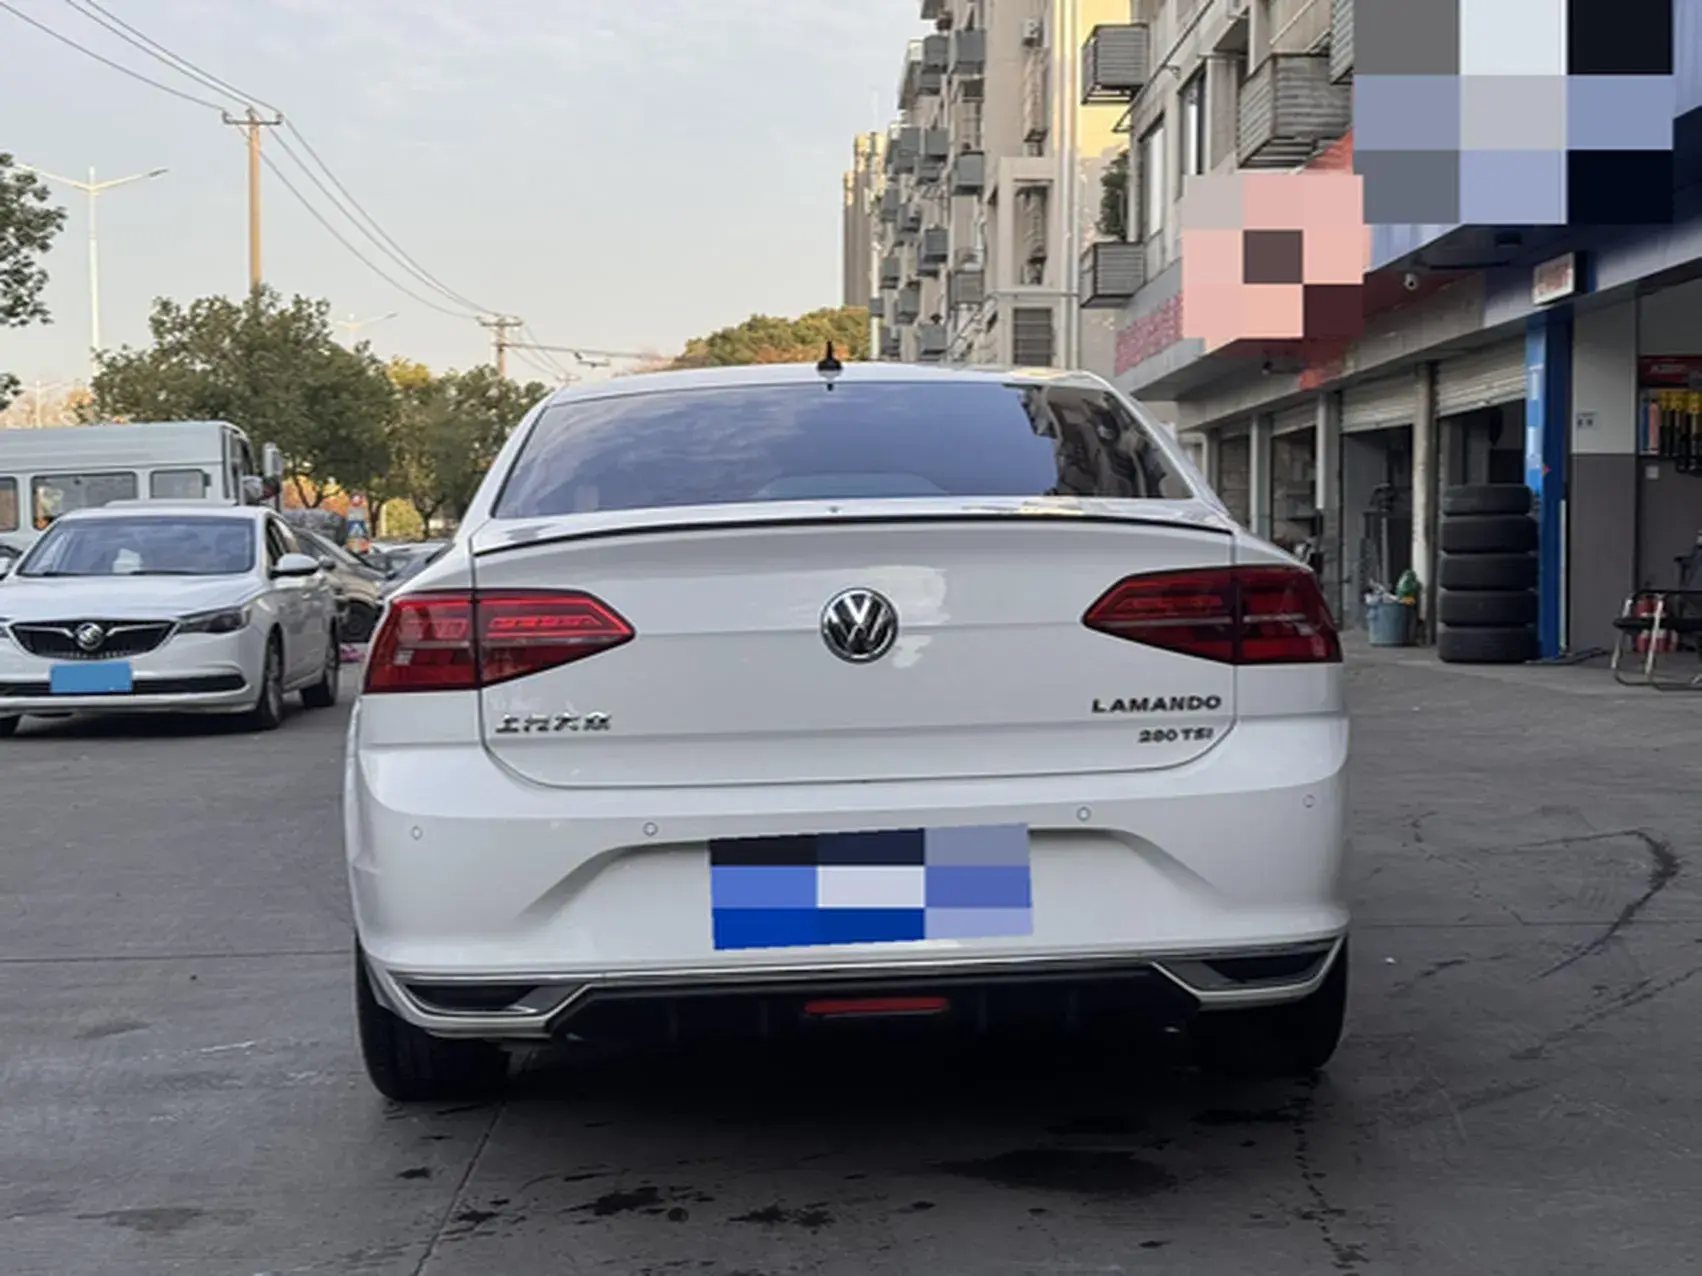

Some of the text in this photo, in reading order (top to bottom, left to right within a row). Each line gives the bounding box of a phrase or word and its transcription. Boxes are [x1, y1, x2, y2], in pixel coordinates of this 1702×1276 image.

[1092, 695, 1221, 713] LAMANDO
[1138, 727, 1214, 743] 280 TSI
